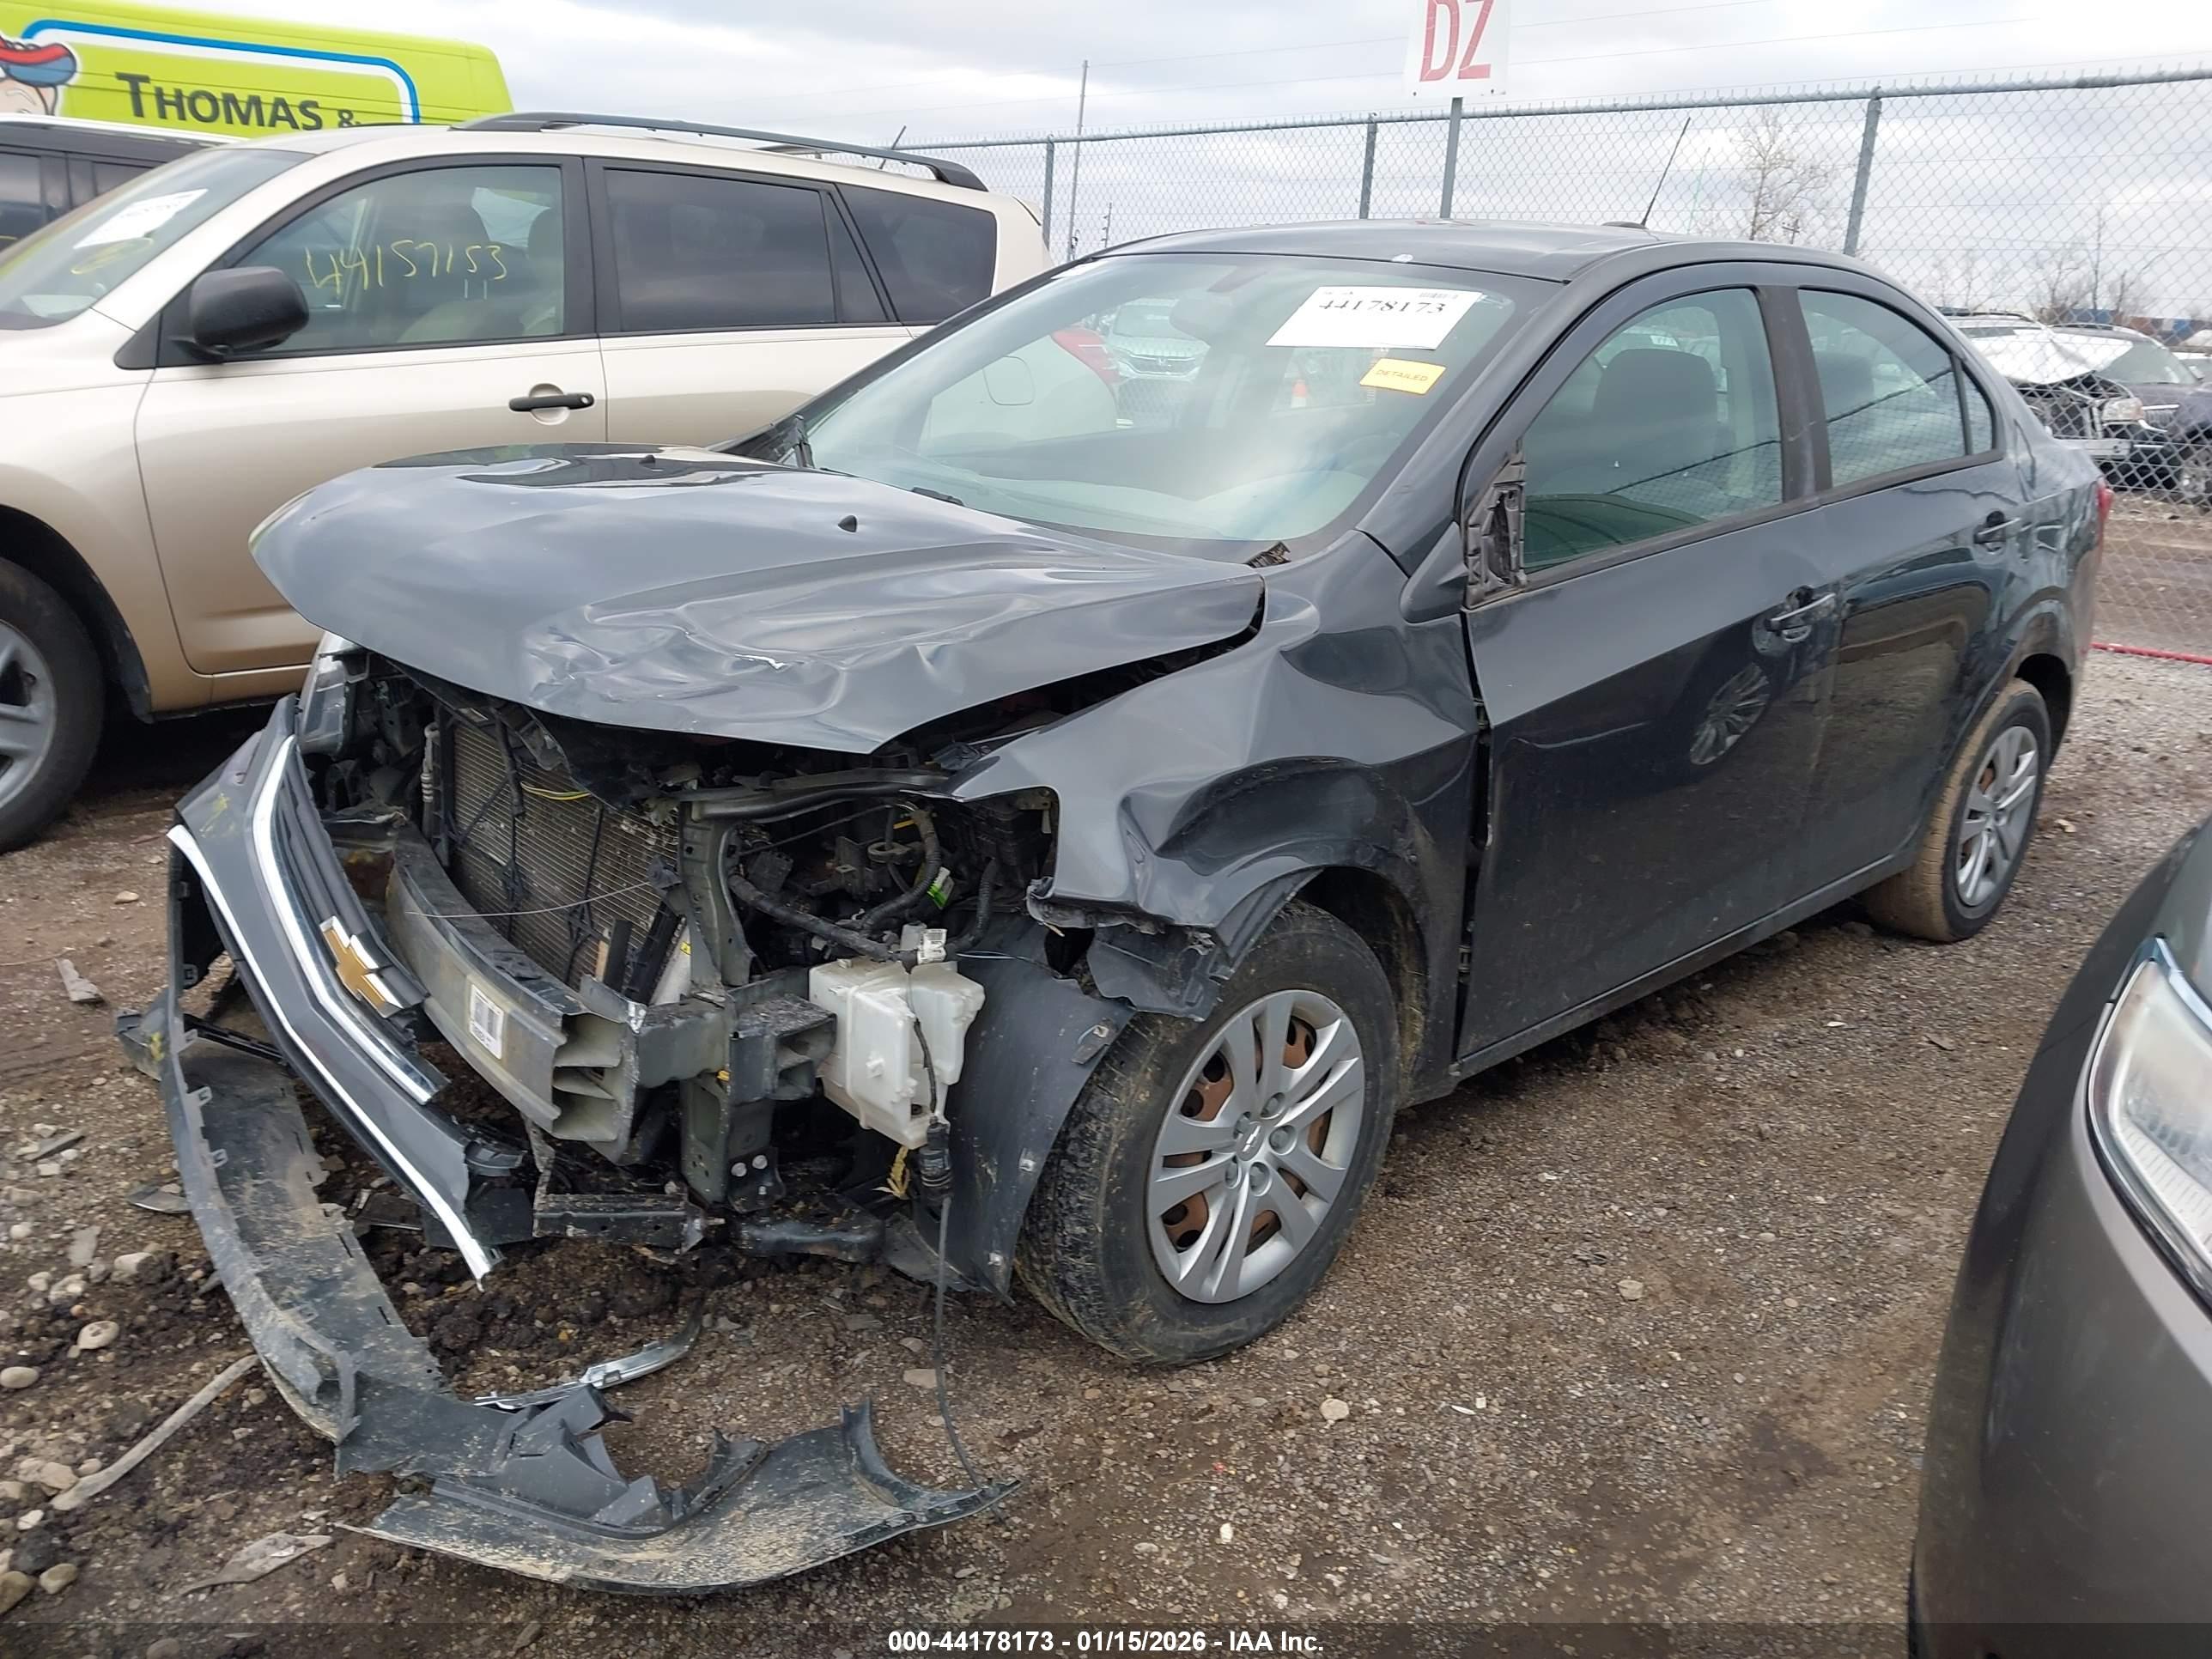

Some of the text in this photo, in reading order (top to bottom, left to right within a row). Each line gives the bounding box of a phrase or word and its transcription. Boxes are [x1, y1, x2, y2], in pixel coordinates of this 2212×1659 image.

[1419, 0, 1494, 82] DZ
[115, 71, 361, 131] THOMAS &
[305, 240, 507, 297] 44157153
[1319, 300, 1446, 313] 44178173
